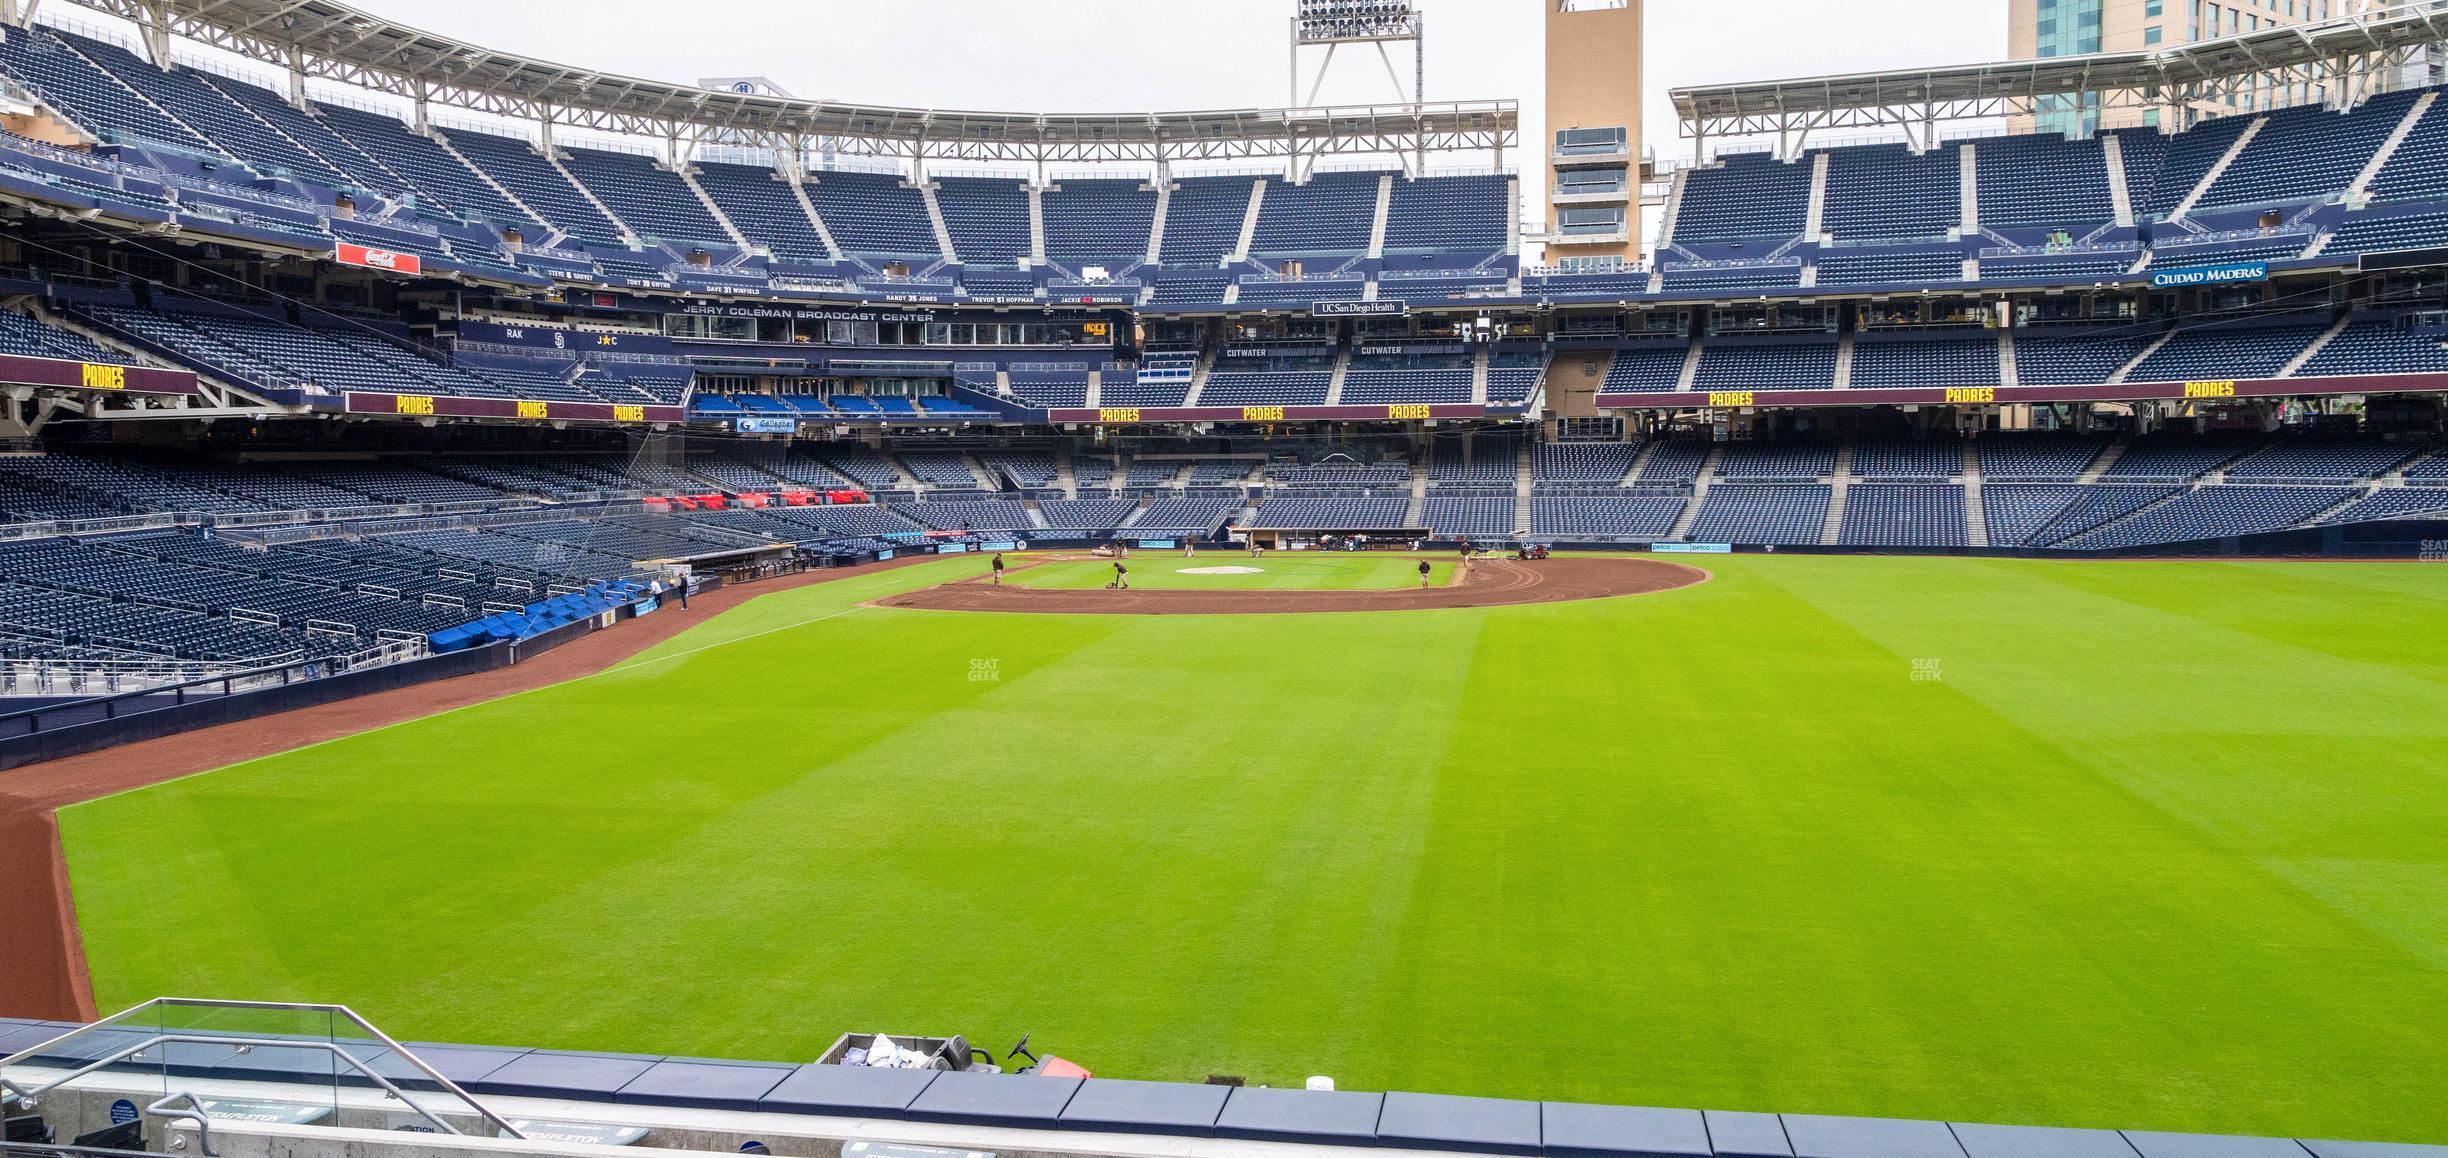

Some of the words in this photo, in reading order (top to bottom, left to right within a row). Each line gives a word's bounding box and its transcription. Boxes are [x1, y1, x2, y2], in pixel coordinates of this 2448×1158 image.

[548, 270, 565, 278] STEVE
[573, 273, 593, 281] GARVEY
[2154, 272, 2203, 285] CIUDAD
[2206, 267, 2263, 281] MADERAS
[651, 281, 671, 289] GWYNN
[706, 285, 722, 293] DAVE
[723, 286, 732, 294] 31
[733, 287, 760, 295] WINFIELD
[683, 305, 724, 314] JERRY
[729, 307, 792, 318] COLEMAN
[797, 310, 877, 321] BROADCAST
[882, 313, 934, 322] CENTER
[1322, 303, 1335, 313] UC
[1335, 303, 1349, 313] San
[1349, 303, 1371, 314] Diego
[1371, 302, 1395, 312] Health
[506, 328, 524, 339] RAK
[1227, 349, 1266, 357] CUTWATER
[1361, 346, 1402, 355] CUTWATER
[82, 364, 124, 389] PADRES
[1946, 387, 1994, 403] PADRES
[2184, 381, 2234, 397] PADRES
[396, 395, 433, 415] PADRES
[1709, 392, 1753, 407] PADRES
[517, 401, 547, 418] PADRES
[613, 405, 644, 421] PADRES
[1099, 409, 1139, 422] PADRES
[1243, 406, 1284, 421] PADRES
[1388, 405, 1430, 419] PADRES
